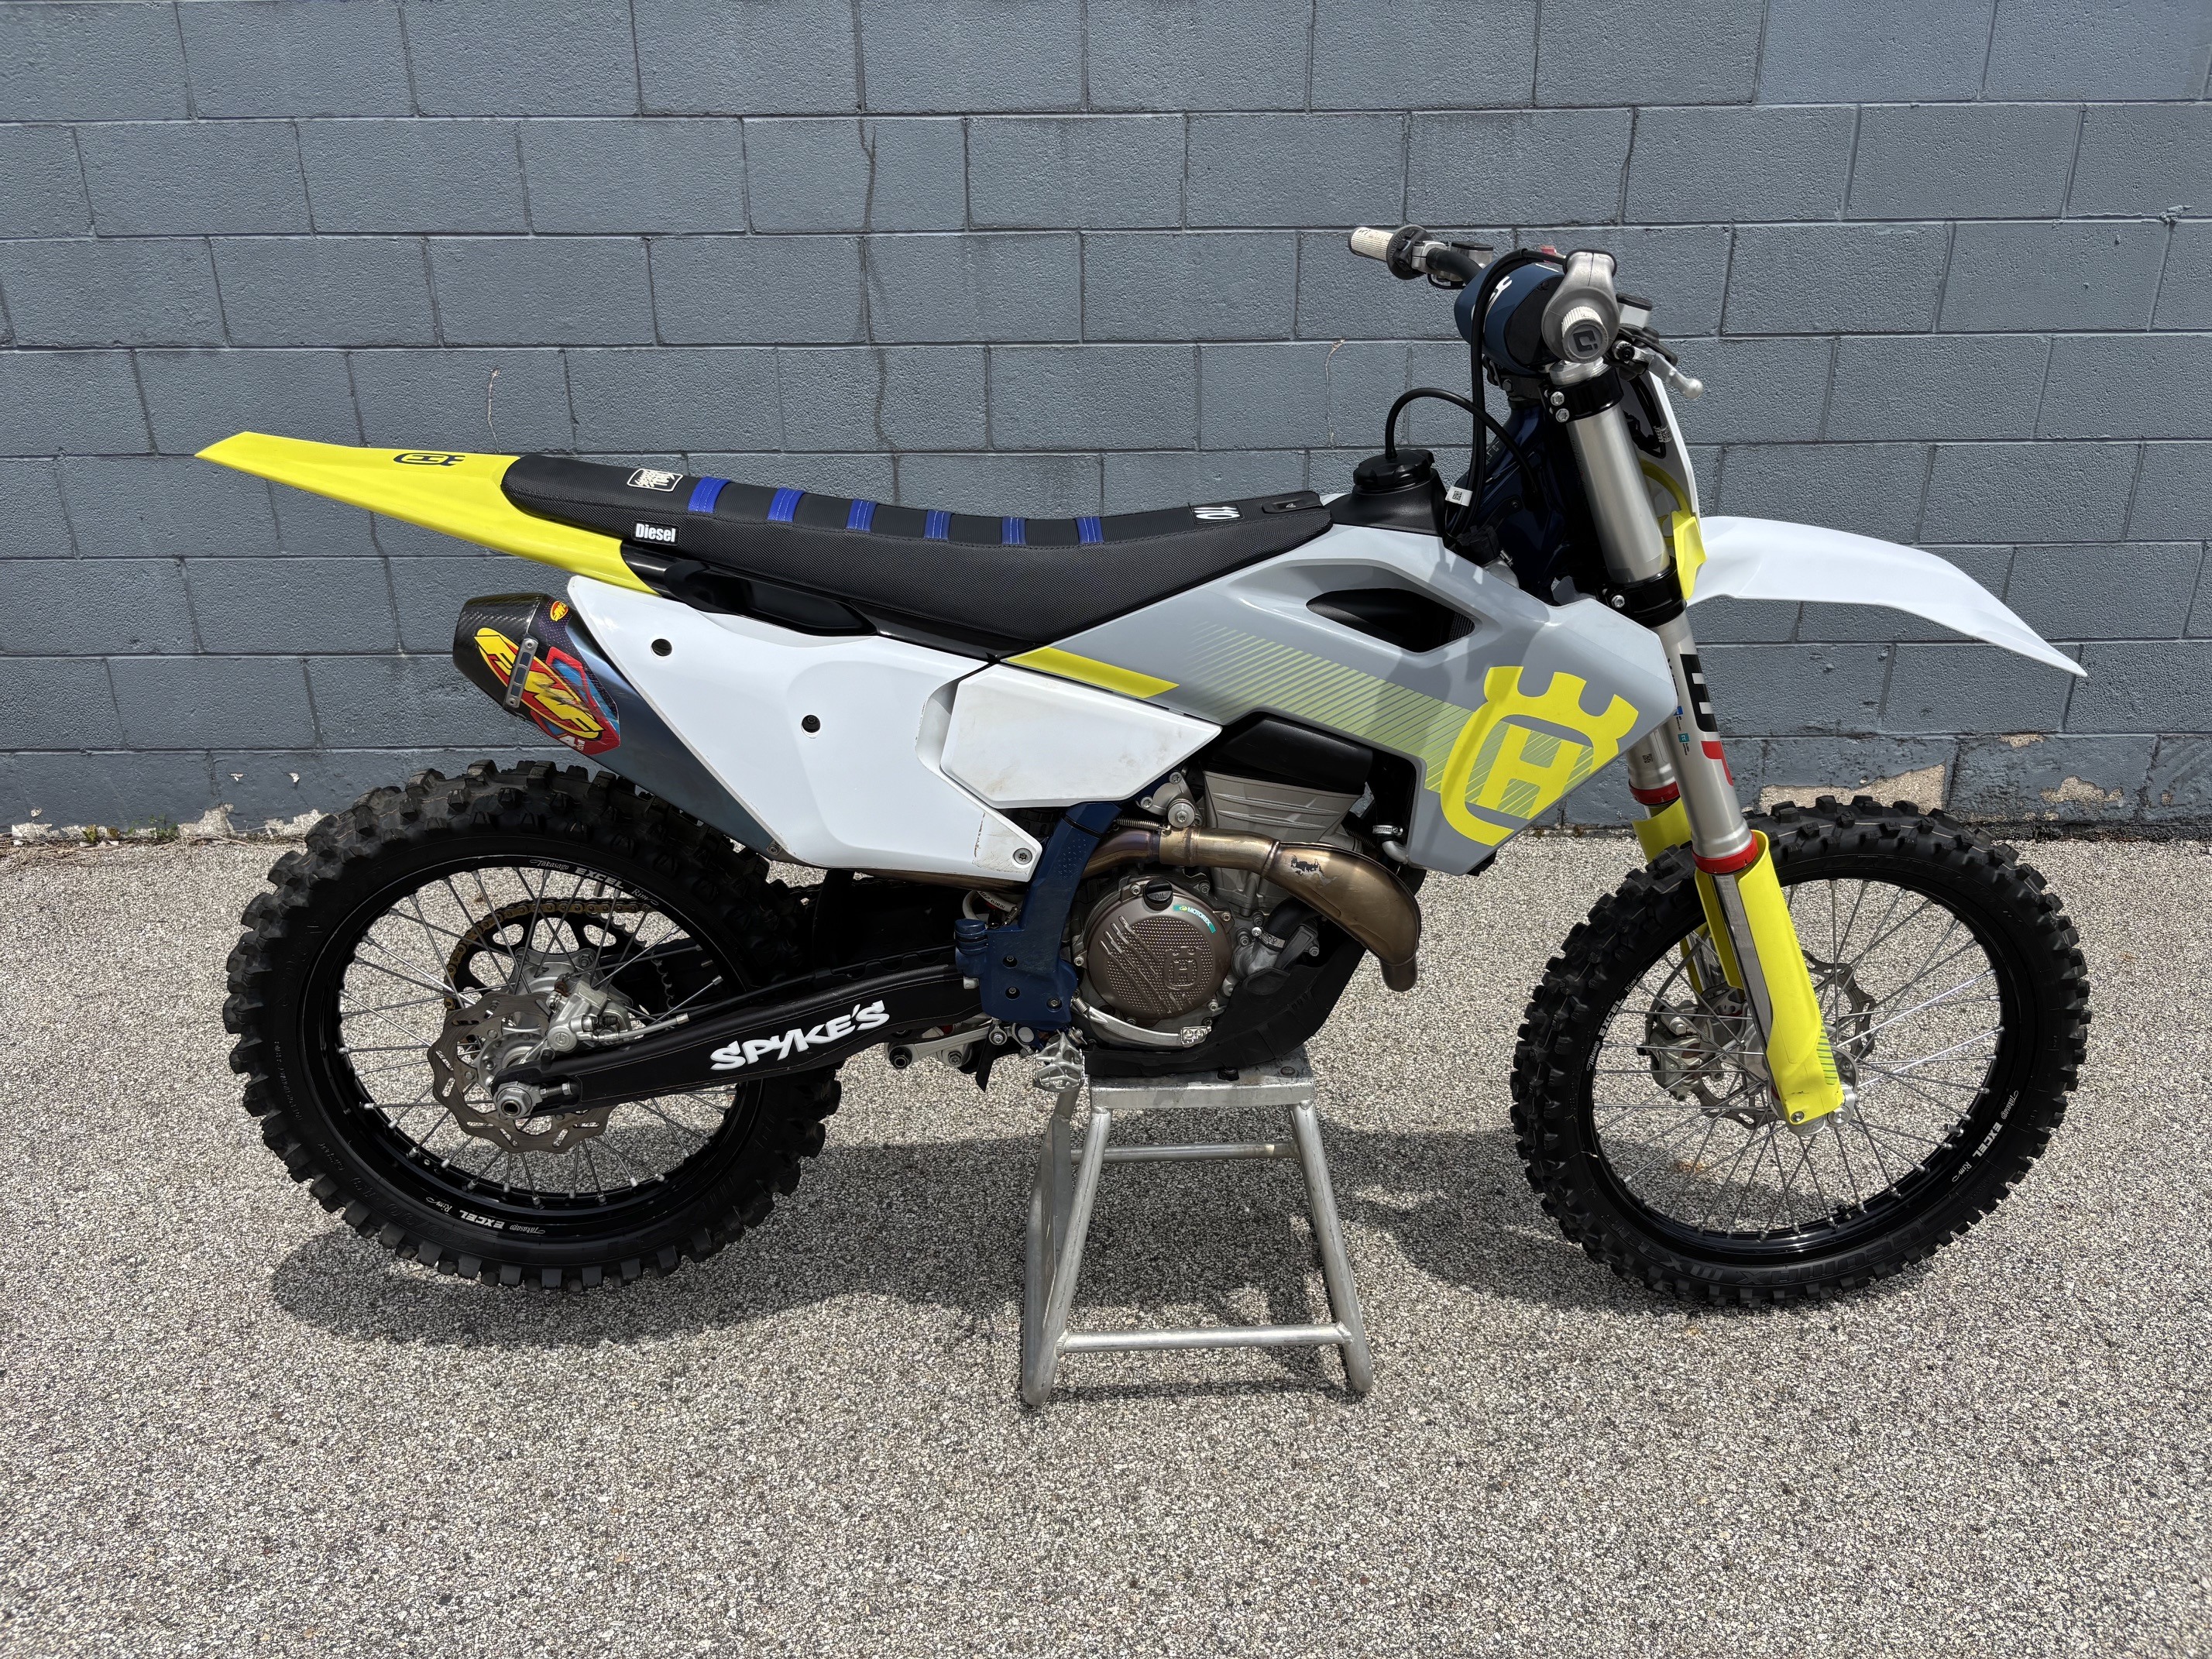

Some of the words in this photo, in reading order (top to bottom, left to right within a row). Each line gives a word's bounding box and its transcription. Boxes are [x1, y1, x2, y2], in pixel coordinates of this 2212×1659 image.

[635, 523, 676, 542] Diesel
[530, 859, 569, 870] Takasago
[575, 867, 624, 889] EXCEL
[1187, 907, 1211, 926] MOTOREX
[1597, 998, 1624, 1037] EXCEL
[709, 1000, 890, 1070] SPYKE'S
[2000, 1090, 2019, 1120] Takasago
[1972, 1121, 2004, 1157] EXCEL
[459, 1209, 505, 1229] EXCEL
[509, 1224, 545, 1235] Takasago
